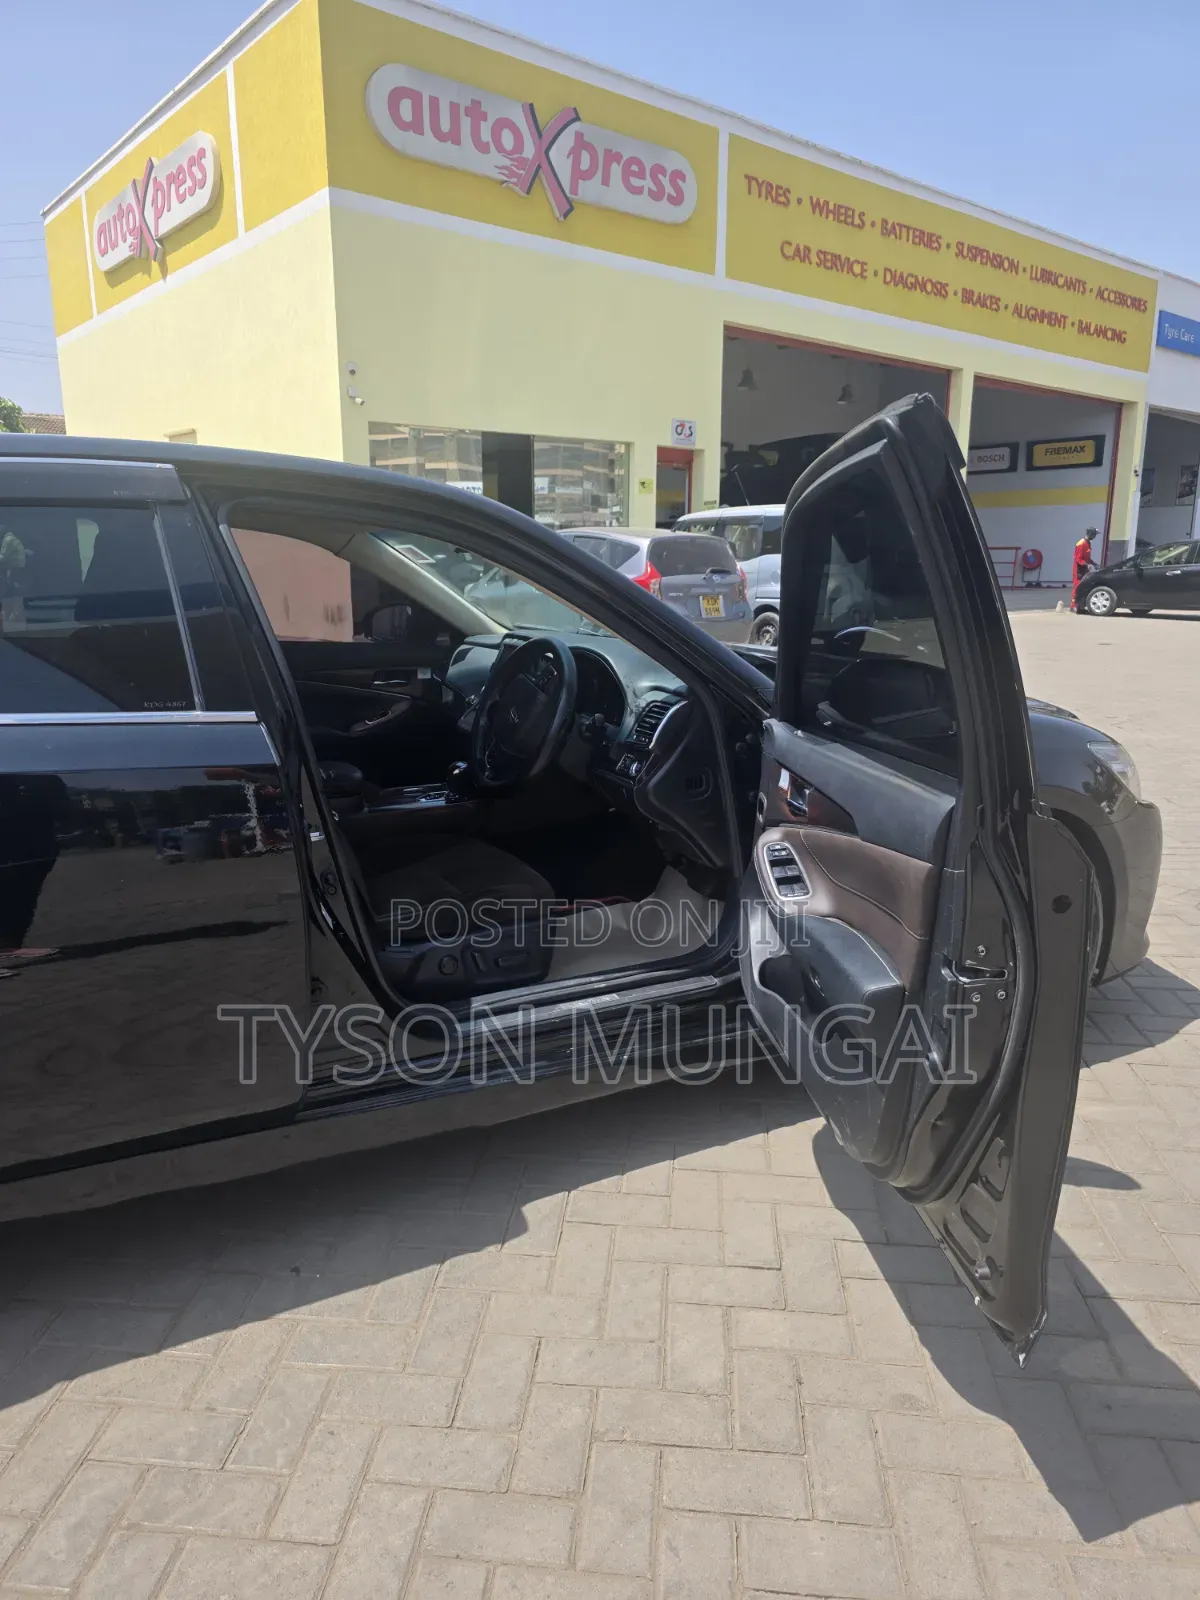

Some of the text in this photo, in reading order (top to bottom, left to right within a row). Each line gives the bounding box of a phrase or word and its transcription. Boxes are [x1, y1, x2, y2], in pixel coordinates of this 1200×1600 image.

[744, 174, 1148, 313] TYRES WHEELS BATTERIES SUSPENSION LUBRICANTS ACCESSORIES
[780, 240, 1128, 344] CAR SERVICE DIAGNOSIS BRAKES ALIGNMENT BALANCING
[1164, 323, 1195, 344] Tyre Care
[976, 453, 1005, 463] BOSCH
[1044, 444, 1086, 456] FREMAX
